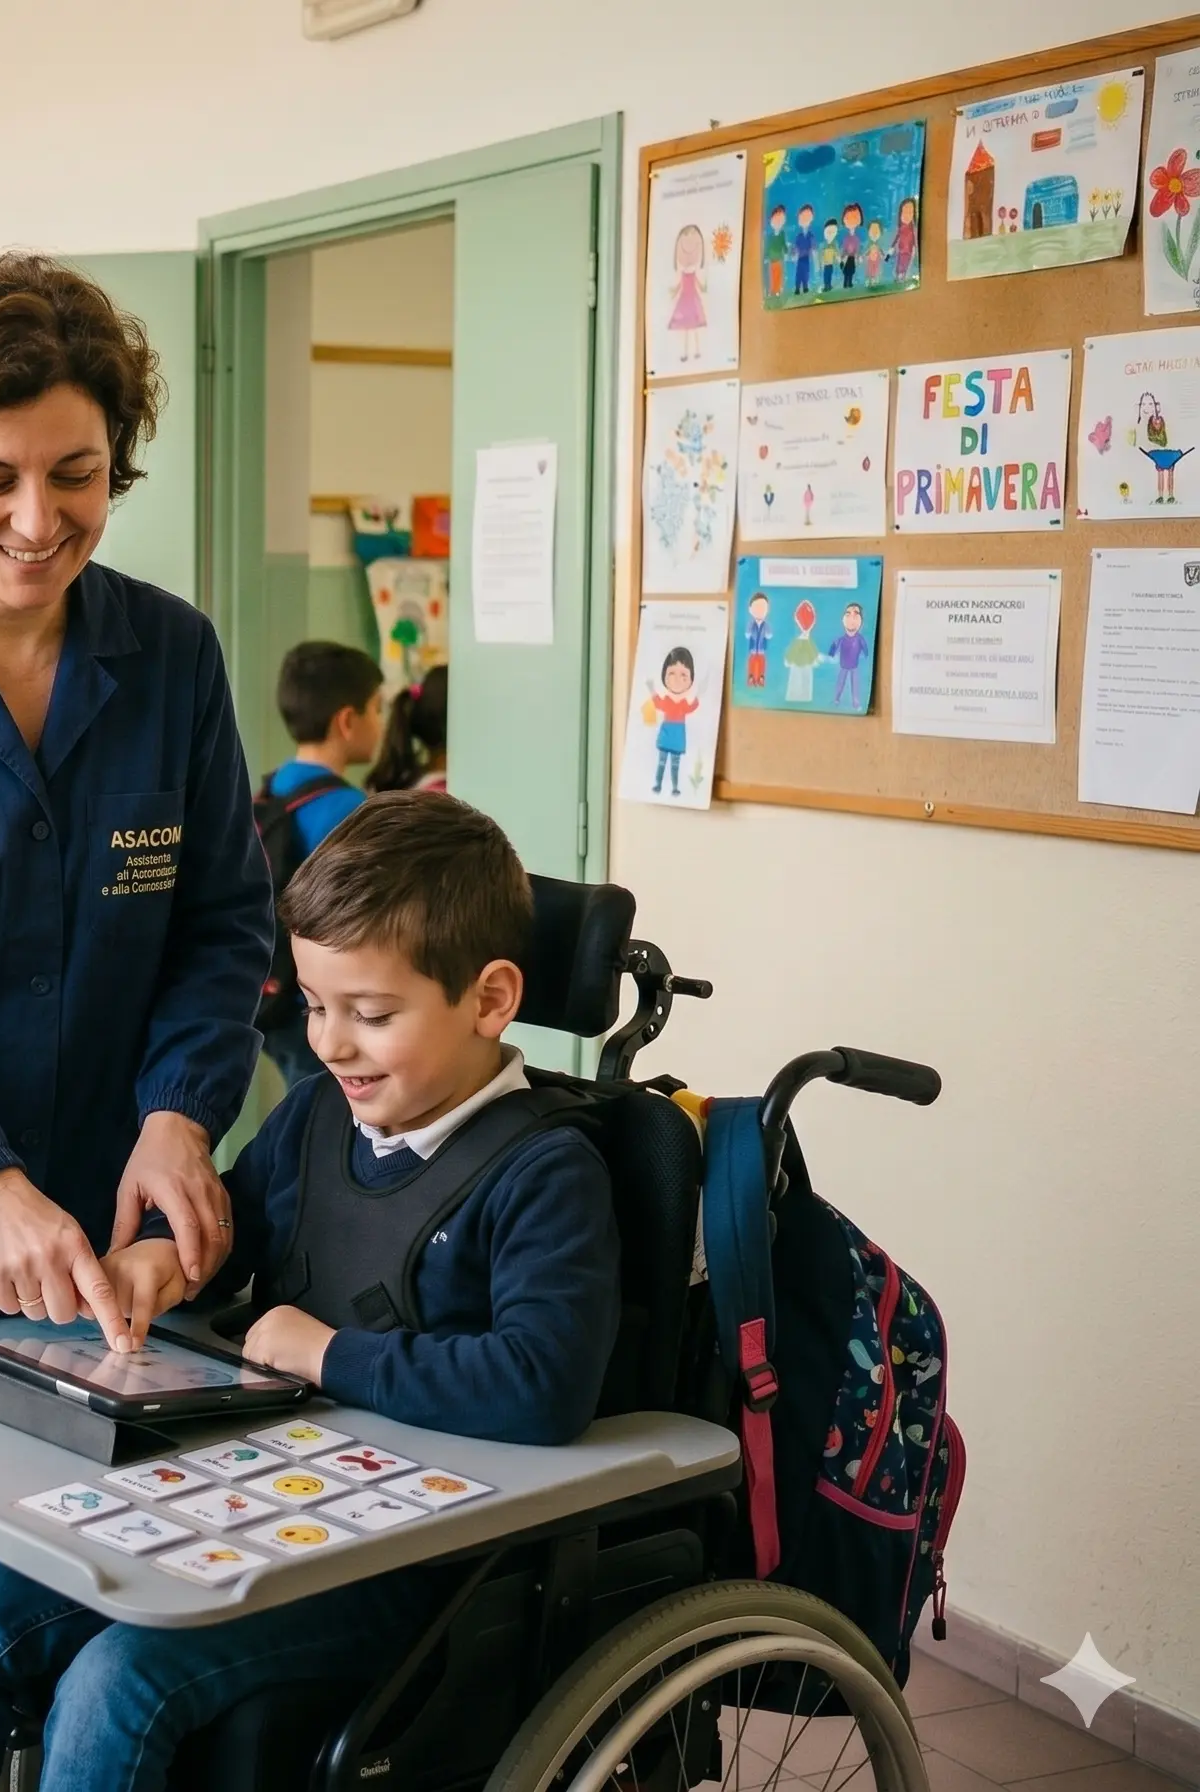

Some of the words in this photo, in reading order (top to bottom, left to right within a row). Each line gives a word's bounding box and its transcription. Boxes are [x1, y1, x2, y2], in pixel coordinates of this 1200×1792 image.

[923, 367, 1034, 419] FESTA
[960, 423, 988, 456] DI
[110, 825, 182, 848] ASACOM
[111, 883, 130, 895] alla
